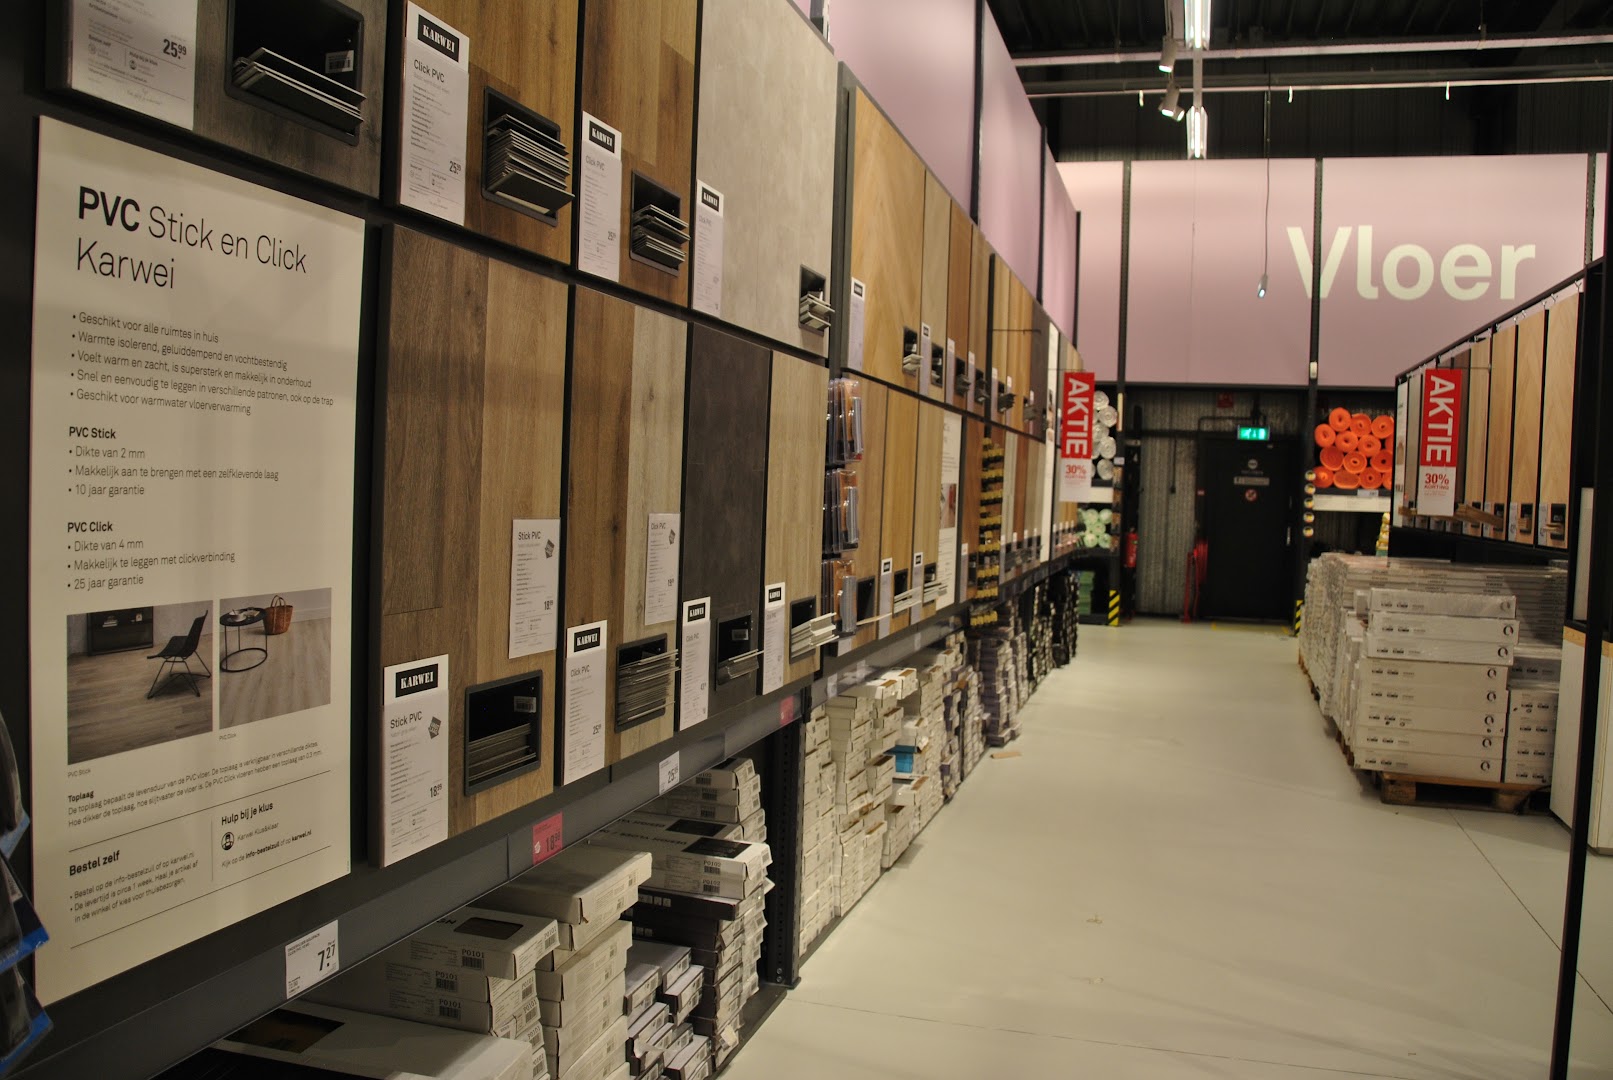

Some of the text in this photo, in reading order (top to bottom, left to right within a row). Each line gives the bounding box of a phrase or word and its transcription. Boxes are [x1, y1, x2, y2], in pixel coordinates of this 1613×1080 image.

[423, 25, 454, 53] KARWEI
[163, 38, 186, 59] 25.99
[413, 59, 444, 82] Click PVC
[591, 128, 612, 146] KARWEI
[704, 192, 718, 207] KARWEI
[79, 186, 306, 274] PVC Stick en Click
[77, 237, 174, 288] Karwei
[1287, 225, 1535, 300] Vloer
[78, 311, 218, 343] Geschikt voor alle ruimtes in huis
[78, 330, 287, 371] Warmte isolerend, geluiddempend en vochtbestendig
[78, 350, 311, 388] Voelt warm en zacht, is supersterk en makkelijk in onderhoud
[77, 369, 333, 407] Snel en eenvoudig te leggen in verschillende patronen, ook op de trap
[76, 388, 250, 415] Geschikt voor warmwater vloerverwarming
[1066, 378, 1090, 455] AKTIE
[1426, 375, 1455, 462] AKTIE
[68, 426, 115, 438] PVC Stick
[75, 446, 145, 458] Dikte van 2 mm
[75, 465, 119, 478] Makkelijk
[120, 468, 137, 476] aan
[139, 466, 148, 476] te
[150, 467, 183, 479] brengen
[186, 468, 201, 477] met
[218, 469, 262, 479] zelfklevende
[264, 470, 278, 481] laag
[1066, 464, 1086, 475] 30%
[1425, 473, 1449, 485] 30%
[74, 484, 144, 497] 10 jaar garantie
[67, 520, 112, 532] PVC Click
[518, 531, 541, 540] Stick PVC
[74, 539, 143, 551] Dikte van 4 mm
[74, 552, 235, 571] Makkelijk te leggen met clickverbinding
[74, 574, 143, 590] 25 jaar garantie
[690, 607, 704, 618] KARWEI
[577, 633, 598, 646] KARWEI
[400, 671, 434, 689] KARWEI
[571, 665, 590, 677] Click PVC
[390, 711, 422, 729] Stick PVC
[67, 790, 94, 803] Toplaag
[430, 783, 442, 798] 18.99
[221, 802, 273, 825] Hulp bij je klus
[221, 859, 230, 868] Kijk
[245, 841, 279, 859] info-bestelzuil
[291, 830, 311, 842] karwei.nl
[69, 851, 120, 876] Bestel zelf
[74, 887, 93, 900] Bestel
[95, 884, 103, 893] op
[104, 881, 112, 889] de
[113, 866, 154, 886] info-bestelzuil
[162, 861, 168, 869] op
[170, 852, 194, 866] karwei.nl
[81, 912, 90, 920] de
[91, 904, 110, 917] winkel
[111, 901, 118, 909] of
[119, 897, 131, 907] kies
[132, 892, 144, 902] voor
[145, 878, 184, 897] thuisbezorgen.
[318, 944, 335, 971] 7.27
[462, 949, 484, 958] P0101
